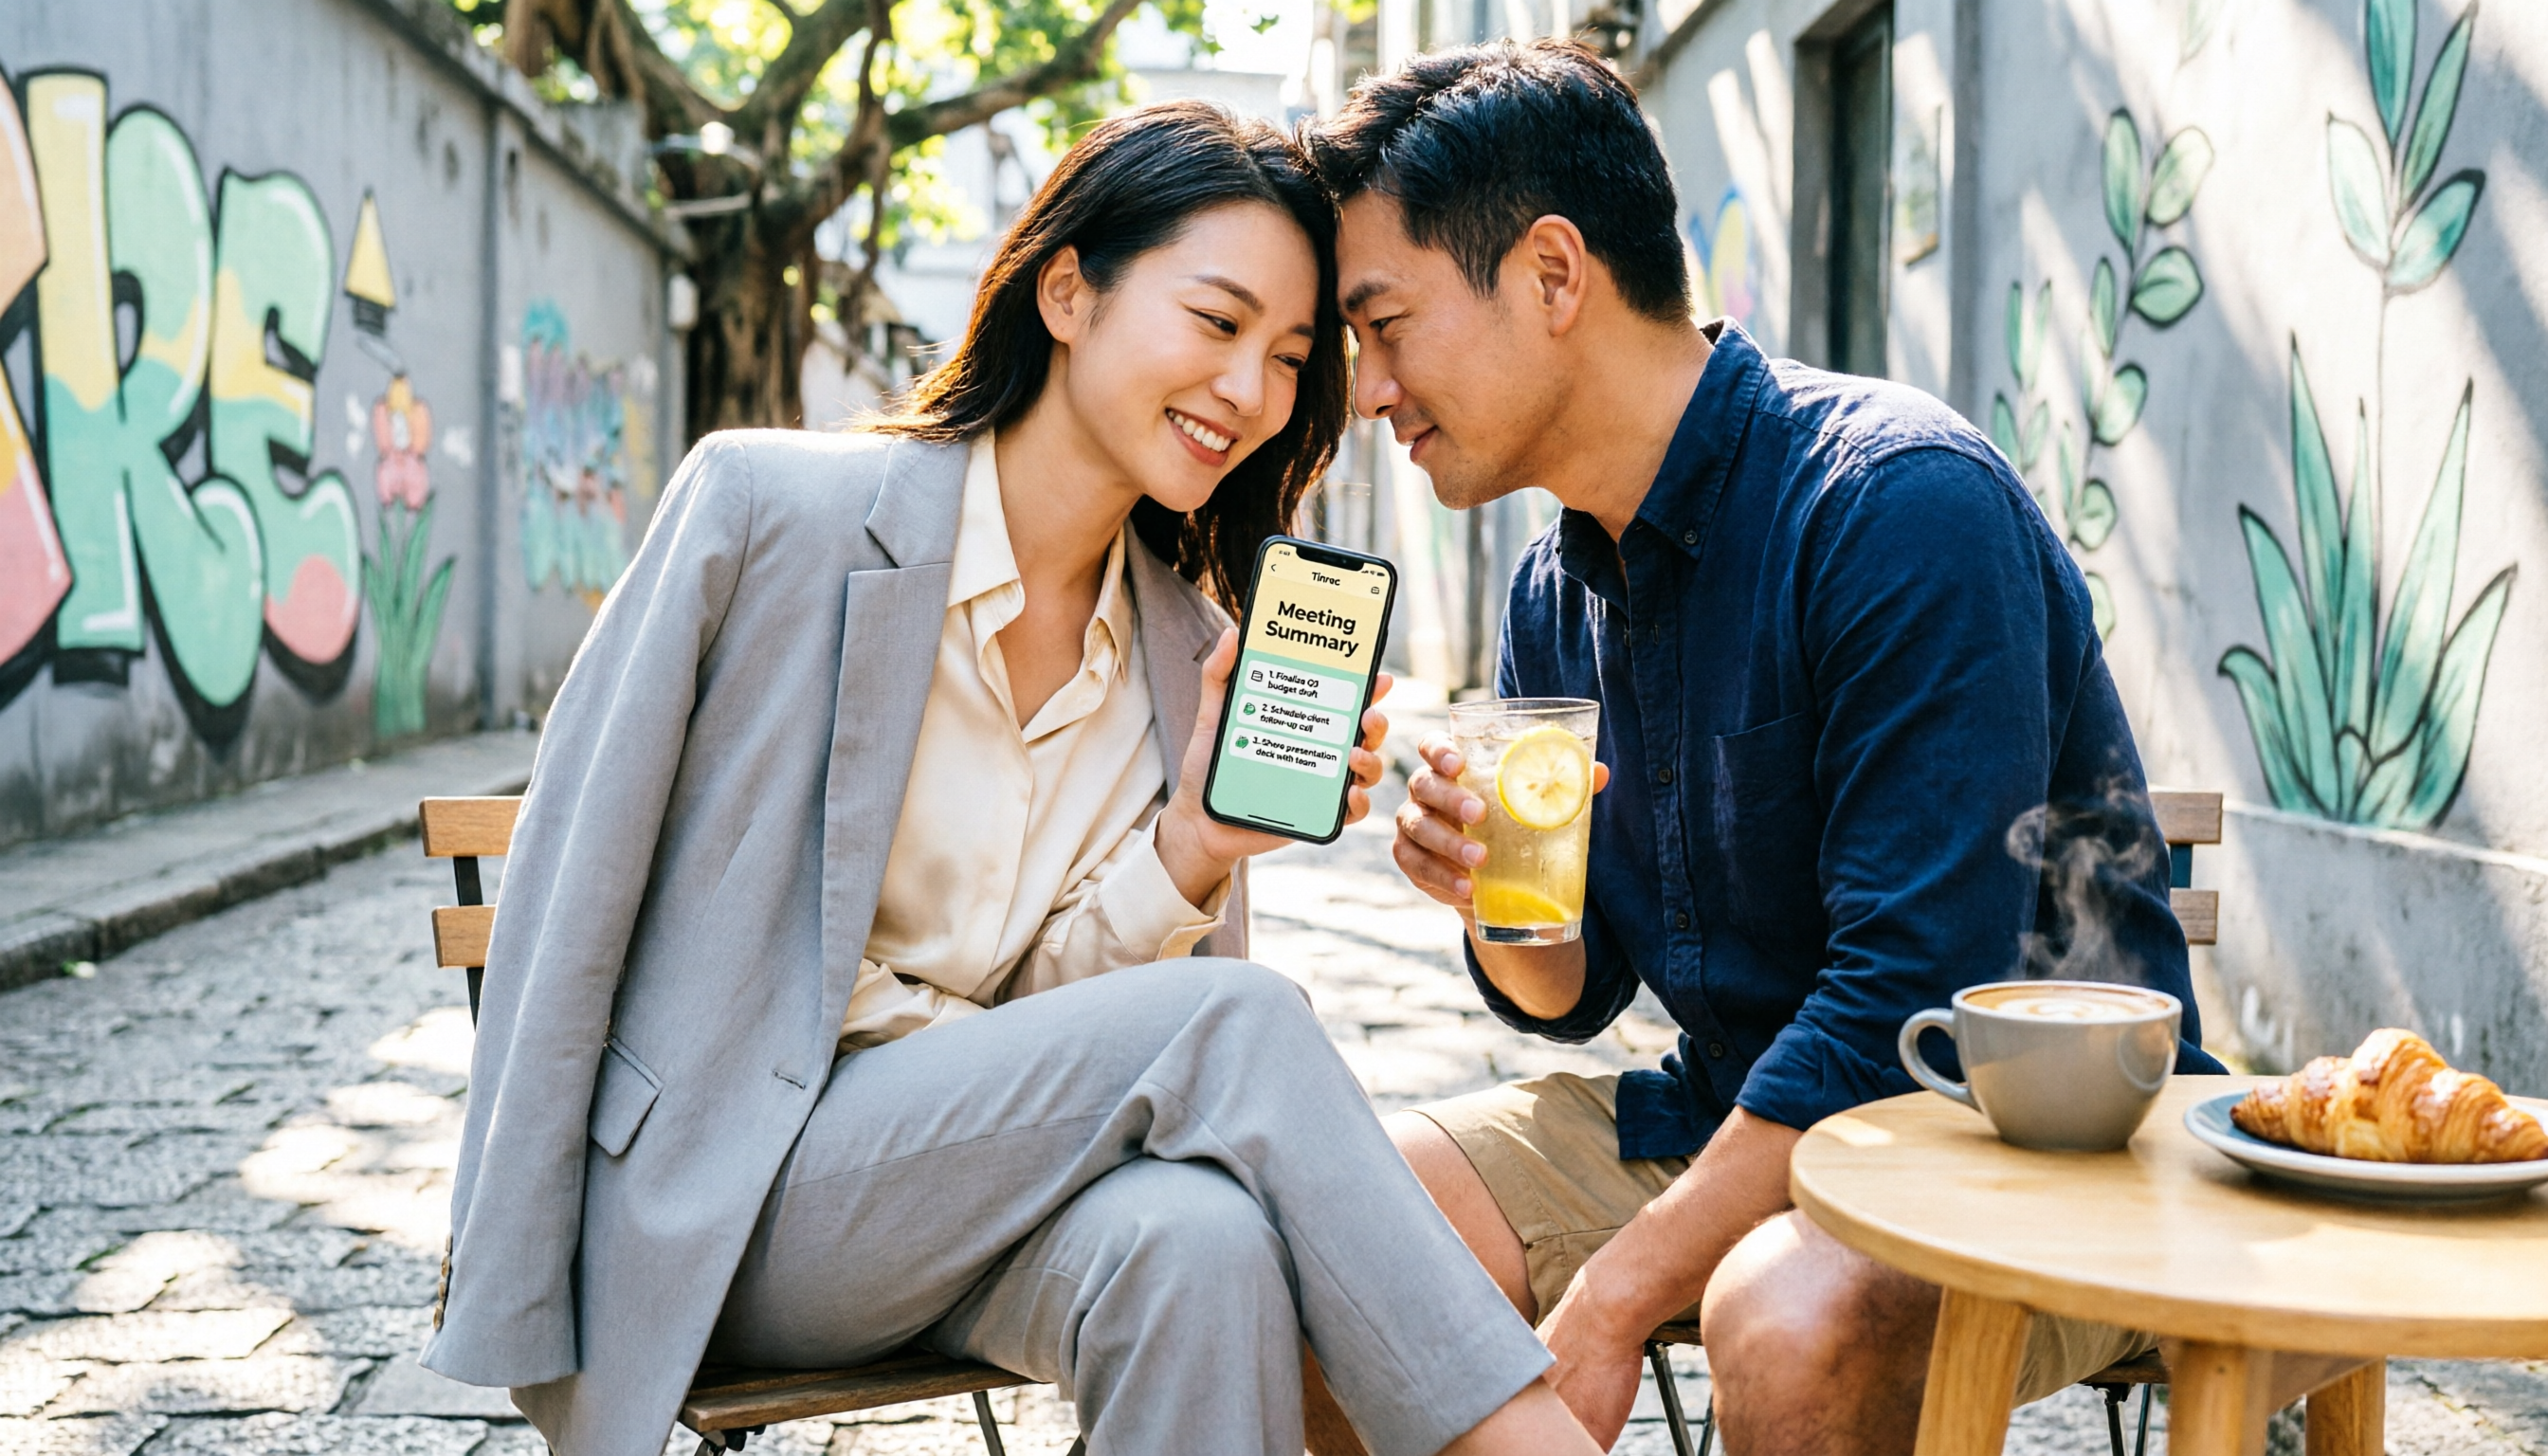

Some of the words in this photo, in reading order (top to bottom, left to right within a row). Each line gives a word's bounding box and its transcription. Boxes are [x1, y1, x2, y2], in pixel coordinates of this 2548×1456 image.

[1278, 601, 1356, 635] Meeting
[1265, 621, 1359, 658] Summary
[1267, 681, 1297, 694] budget
[1286, 745, 1338, 761] presentation
